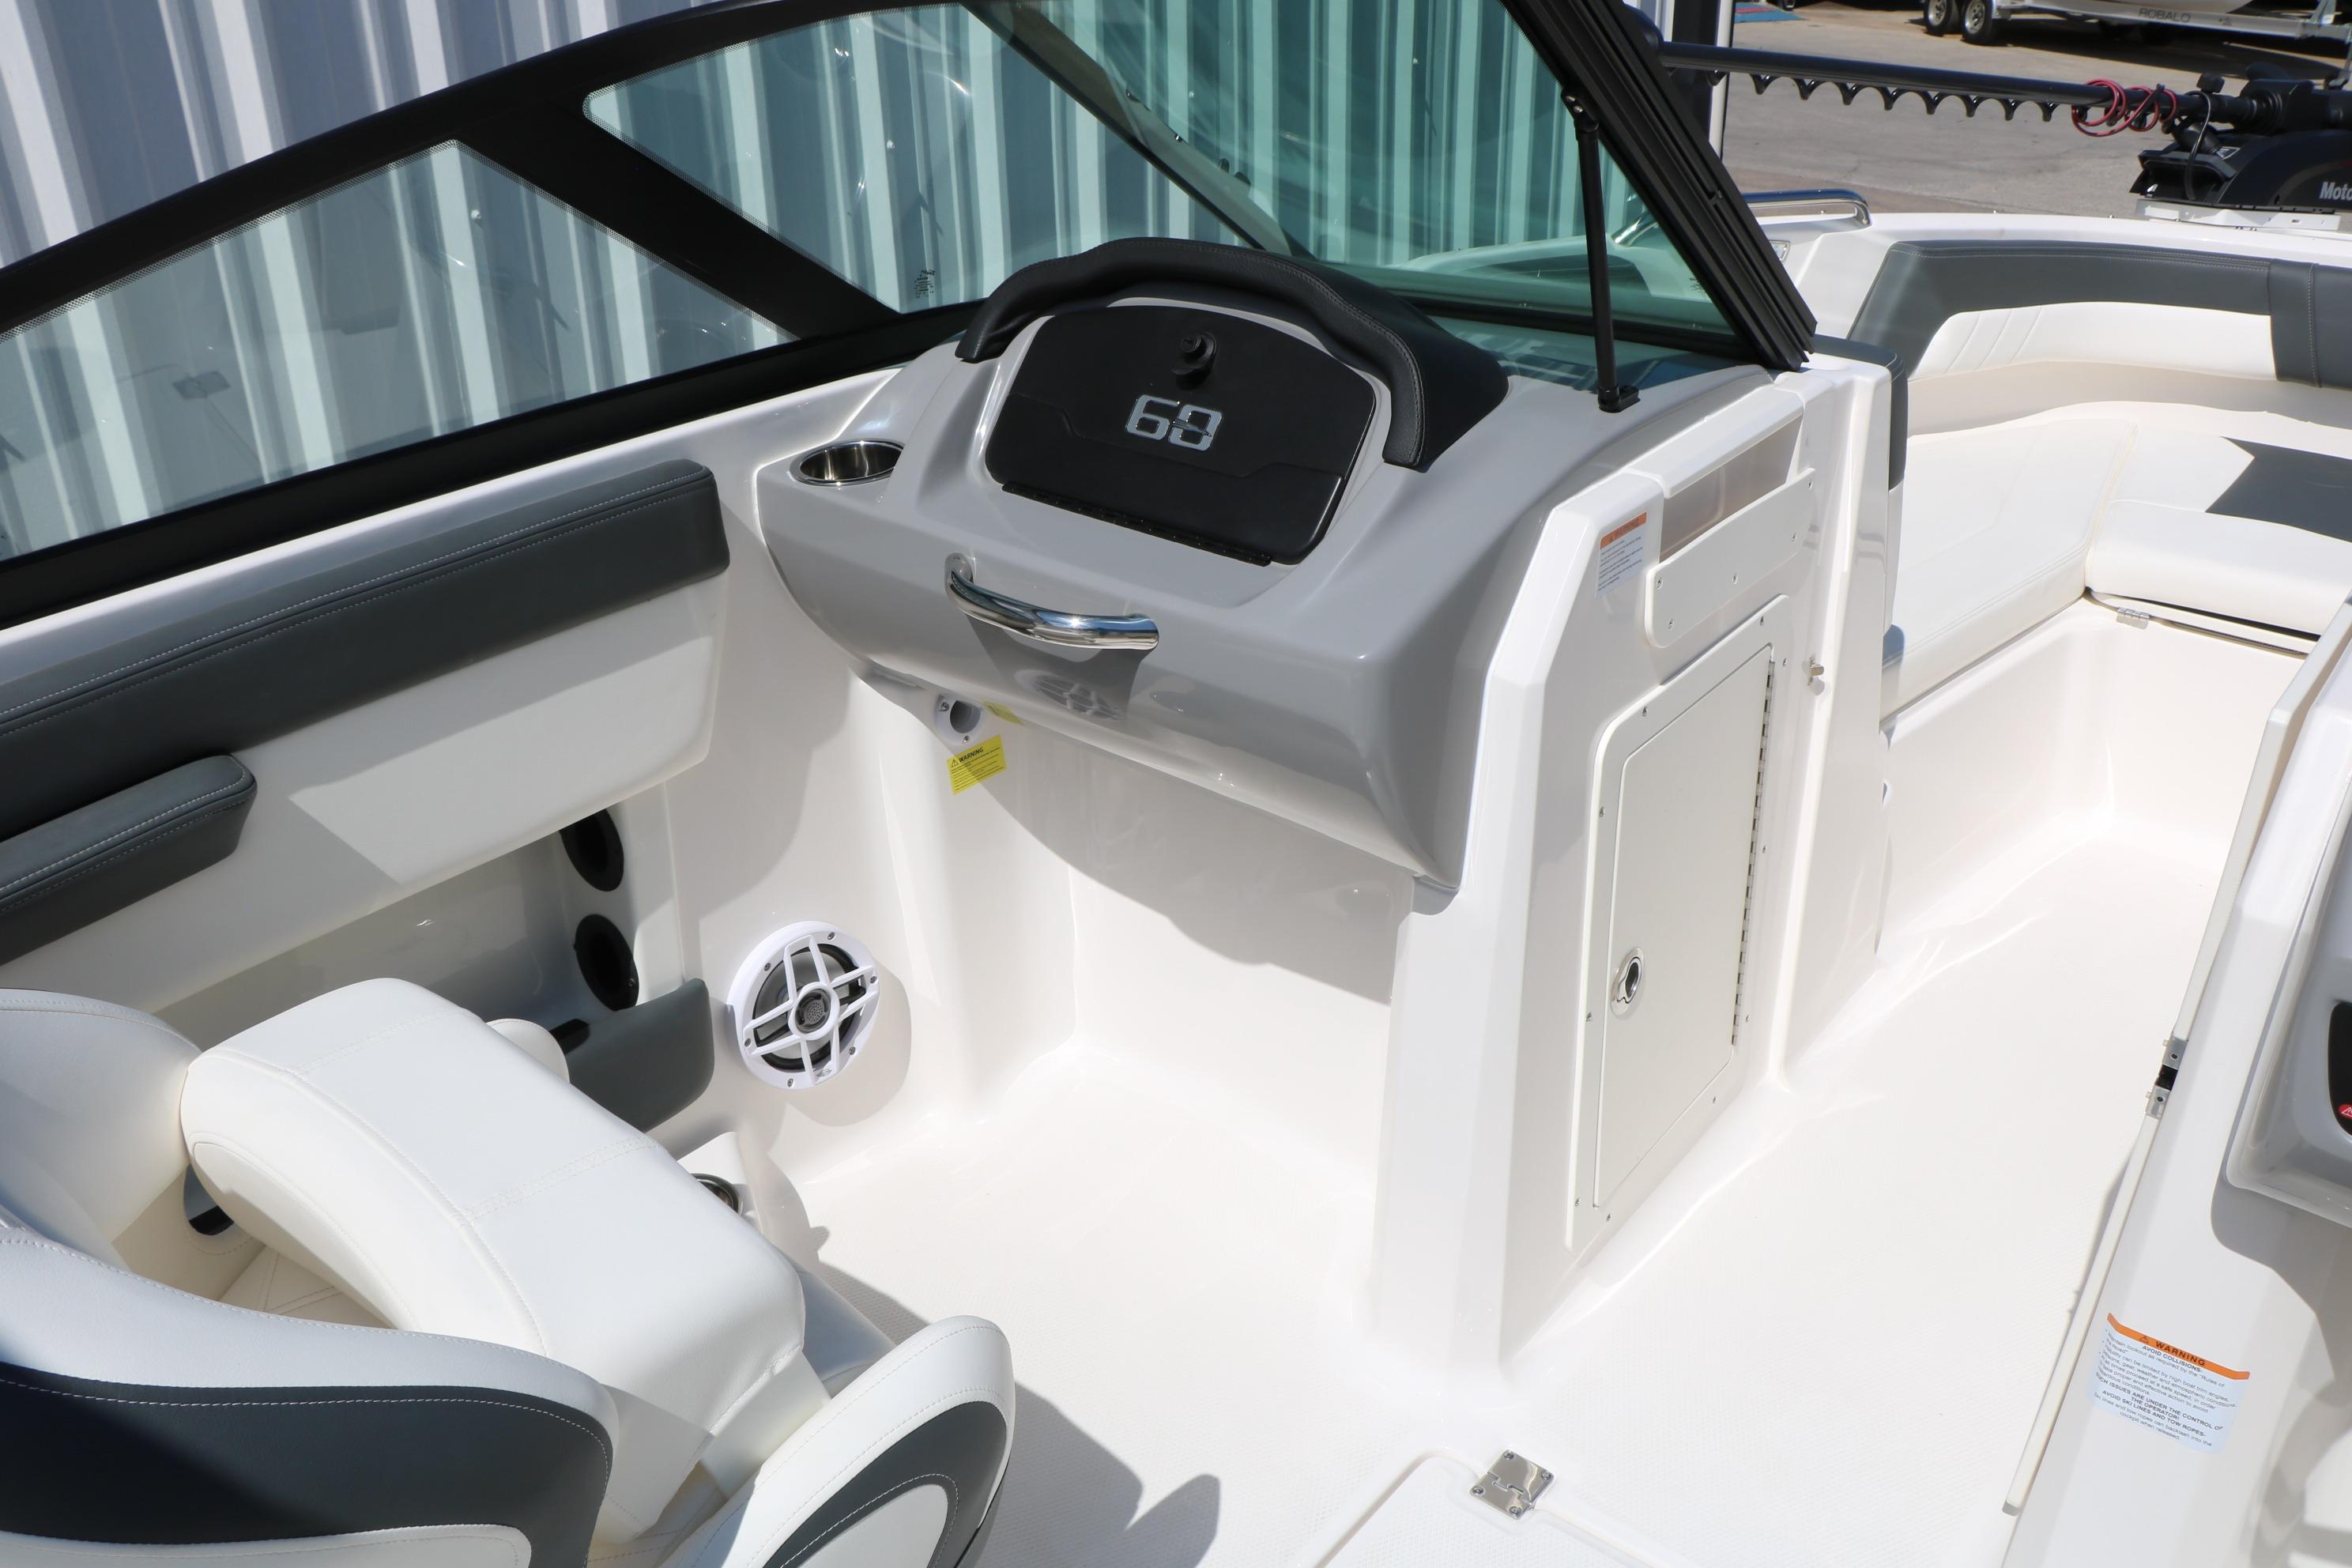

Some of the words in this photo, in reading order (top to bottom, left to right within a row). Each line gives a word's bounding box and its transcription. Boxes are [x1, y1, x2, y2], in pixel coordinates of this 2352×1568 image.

[2139, 8, 2191, 23] ROBALO
[959, 747, 984, 763] WARNING
[2127, 1344, 2147, 1356] lookout
[2156, 1357, 2180, 1370] required
[2143, 1346, 2162, 1355] AVOID
[2156, 1341, 2205, 1366] WARNING
[2137, 1368, 2158, 1379] weather
[2171, 1383, 2205, 1400] atmospheric
[2142, 1363, 2160, 1374] limited
[2169, 1375, 2182, 1384] high
[2183, 1380, 2196, 1389] boat
[2114, 1370, 2132, 1381] proper
[2144, 1383, 2166, 1396] effective
[2167, 1393, 2184, 1404] action
[2192, 1404, 2208, 1413] avoid
[2126, 1370, 2149, 1381] proceed
[2200, 1400, 2215, 1409] order
[2102, 1390, 2120, 1401] AVOID
[2133, 1404, 2151, 1414] LINES
[2152, 1412, 2165, 1420] AND
[2167, 1417, 2181, 1427] TOW
[2109, 1381, 2131, 1394] ISSUES
[2146, 1397, 2168, 1409] UNDER
[2169, 1407, 2181, 1415] THE
[2182, 1412, 2213, 1429] CONTROL
[2132, 1396, 2143, 1405] THE
[2144, 1402, 2180, 1420] OPERATOR!
[2120, 1412, 2139, 1422] cockpit
[2140, 1420, 2155, 1430] when
[2137, 1412, 2153, 1422] ropes
[2165, 1424, 2190, 1438] backlash
[2191, 1434, 2202, 1443] into
